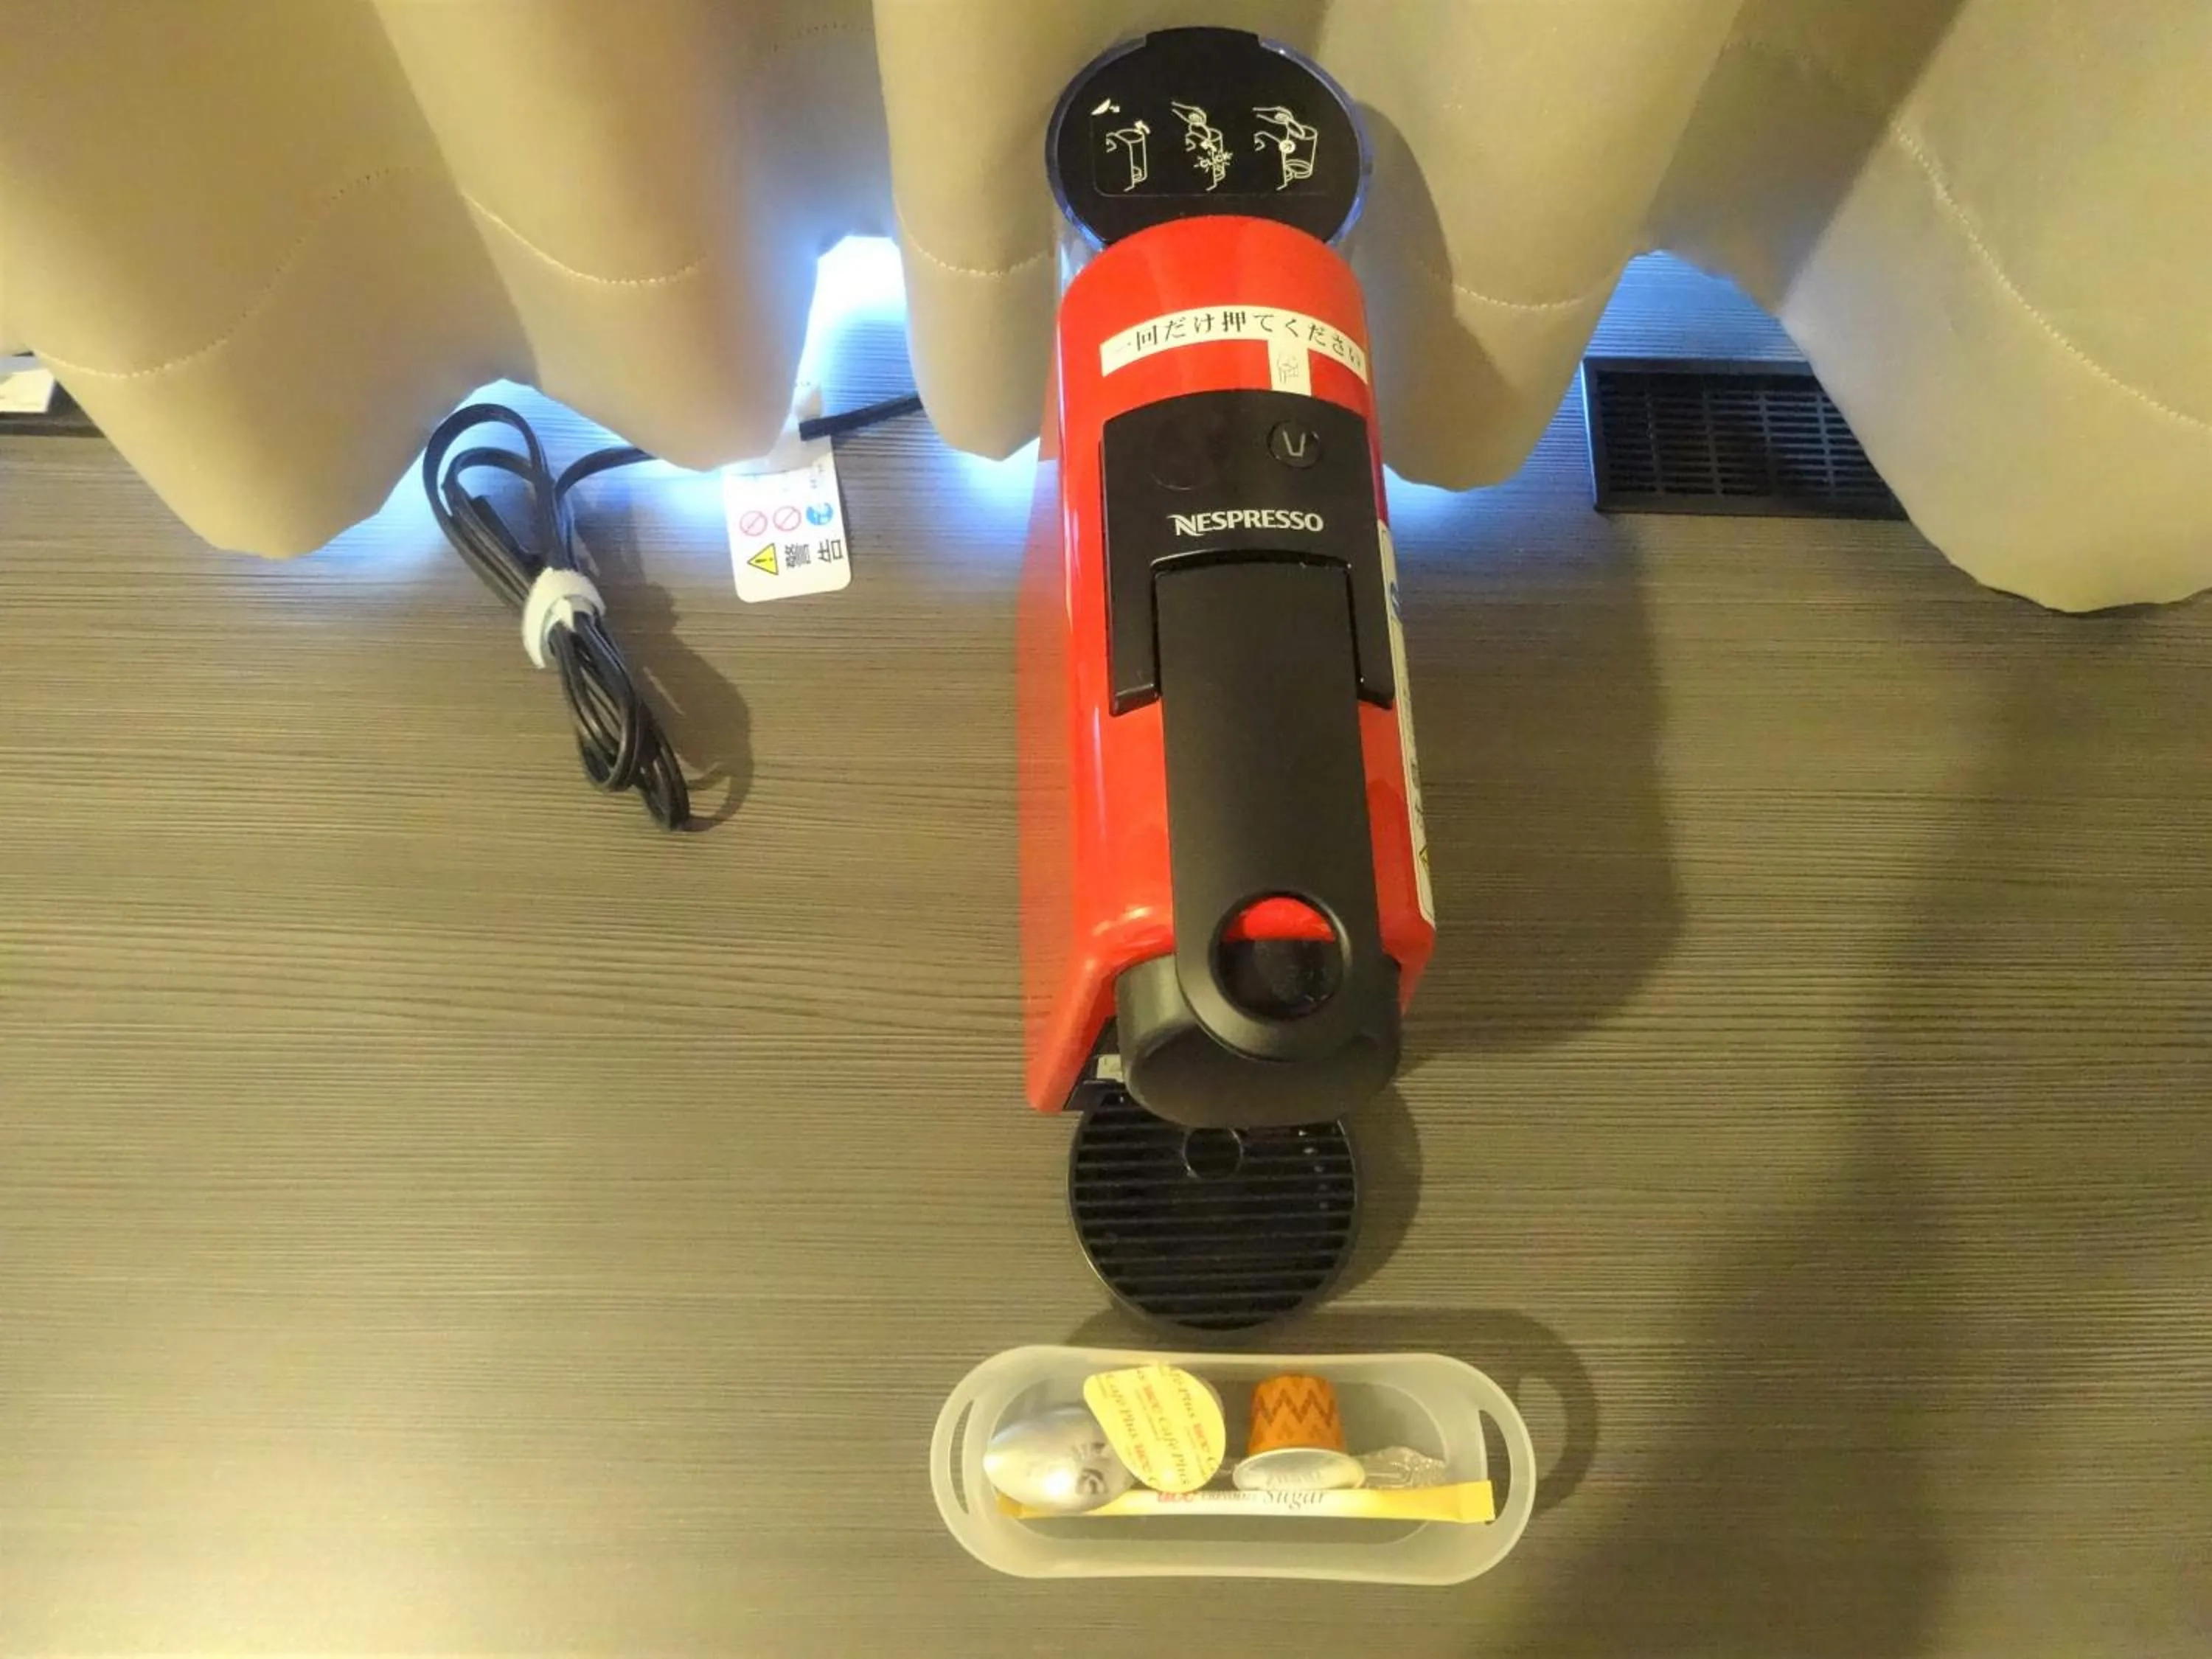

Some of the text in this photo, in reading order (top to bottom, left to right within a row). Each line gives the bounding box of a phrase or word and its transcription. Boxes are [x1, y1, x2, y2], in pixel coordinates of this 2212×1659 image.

[1114, 311, 1362, 368] 一回だけ押てください
[1167, 509, 1324, 537] NESPRESSO
[785, 539, 844, 569] 警告
